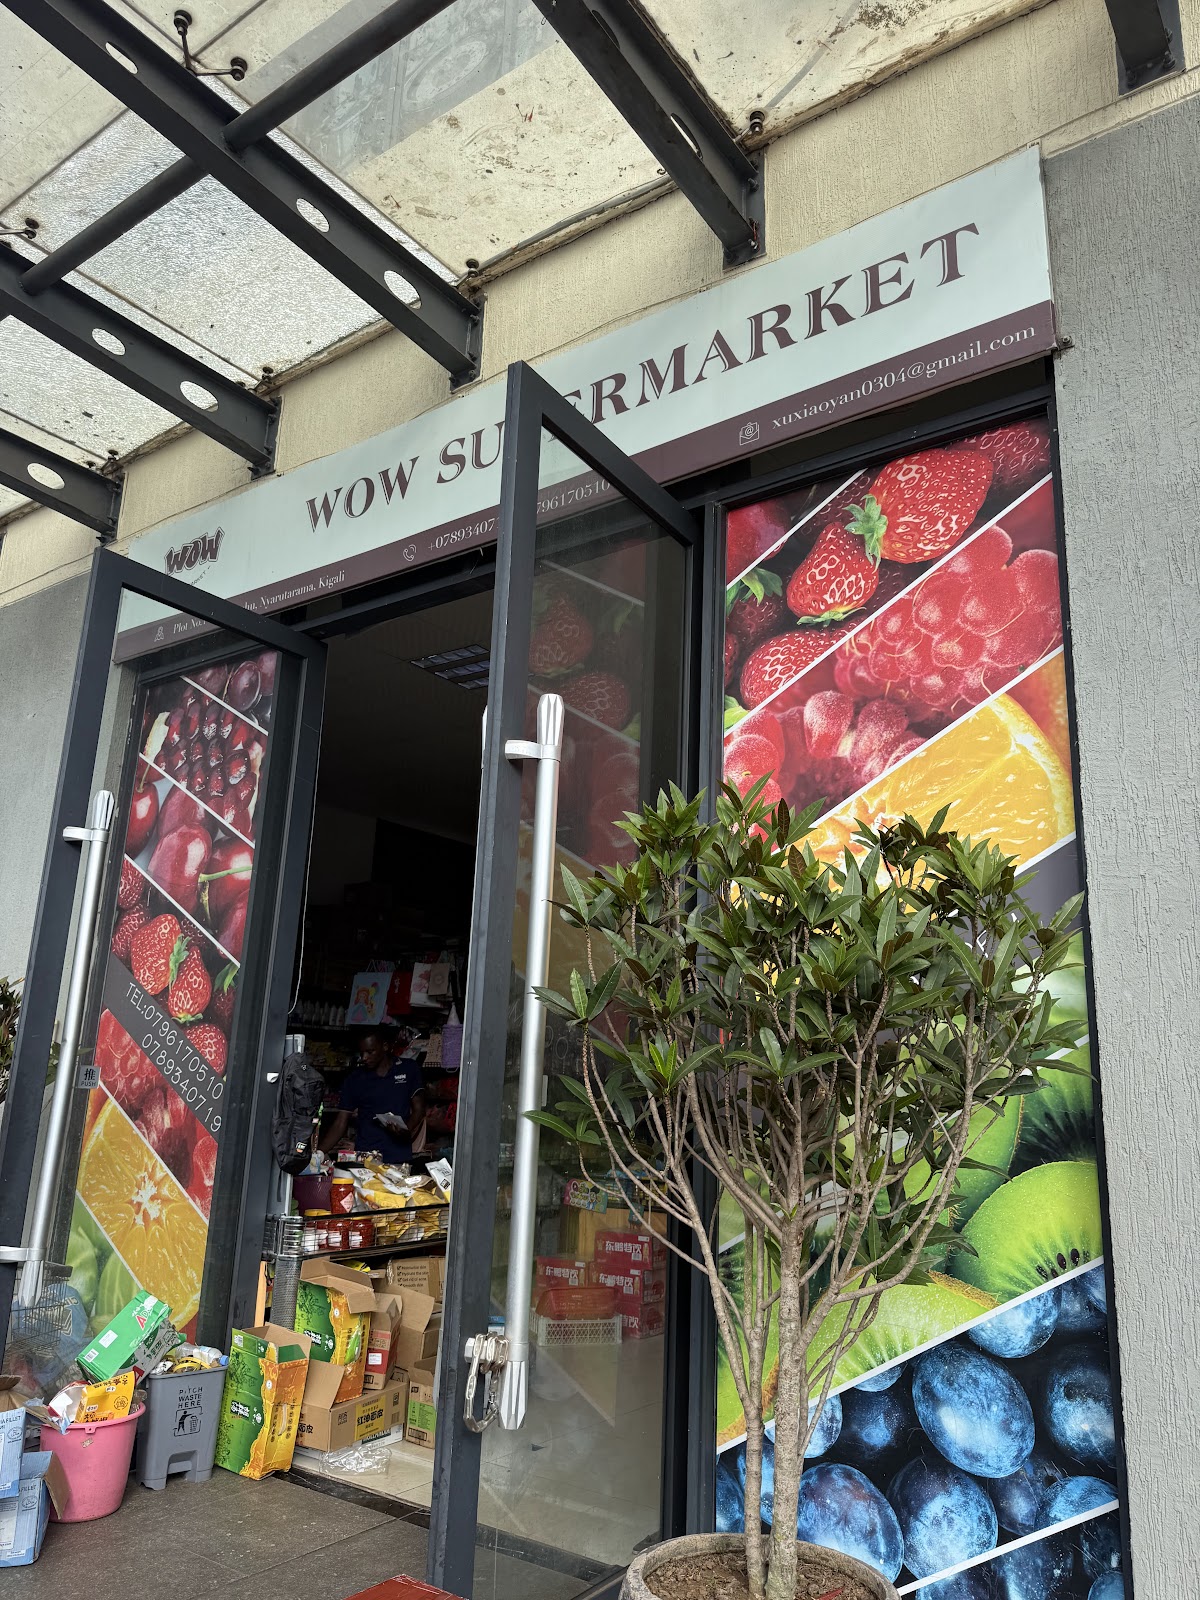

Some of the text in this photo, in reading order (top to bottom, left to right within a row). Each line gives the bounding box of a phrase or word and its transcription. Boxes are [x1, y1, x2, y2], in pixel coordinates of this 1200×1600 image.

[306, 222, 979, 533] WOW SURMARKET
[772, 324, 1037, 430] xuxiaoyan0304@gmail.com
[428, 479, 611, 551] +07893407 796170510
[164, 526, 226, 577] WOW
[173, 621, 189, 634] Plot
[260, 581, 316, 610] Nyarutarama,
[318, 571, 346, 591] Kigali
[125, 982, 224, 1100] TEL:0796170510
[84, 1067, 96, 1081] 推
[142, 1033, 222, 1132] 0789340719
[178, 1393, 202, 1402] WASTE
[178, 1400, 201, 1409] HERE
[179, 1386, 203, 1395] PITCH
